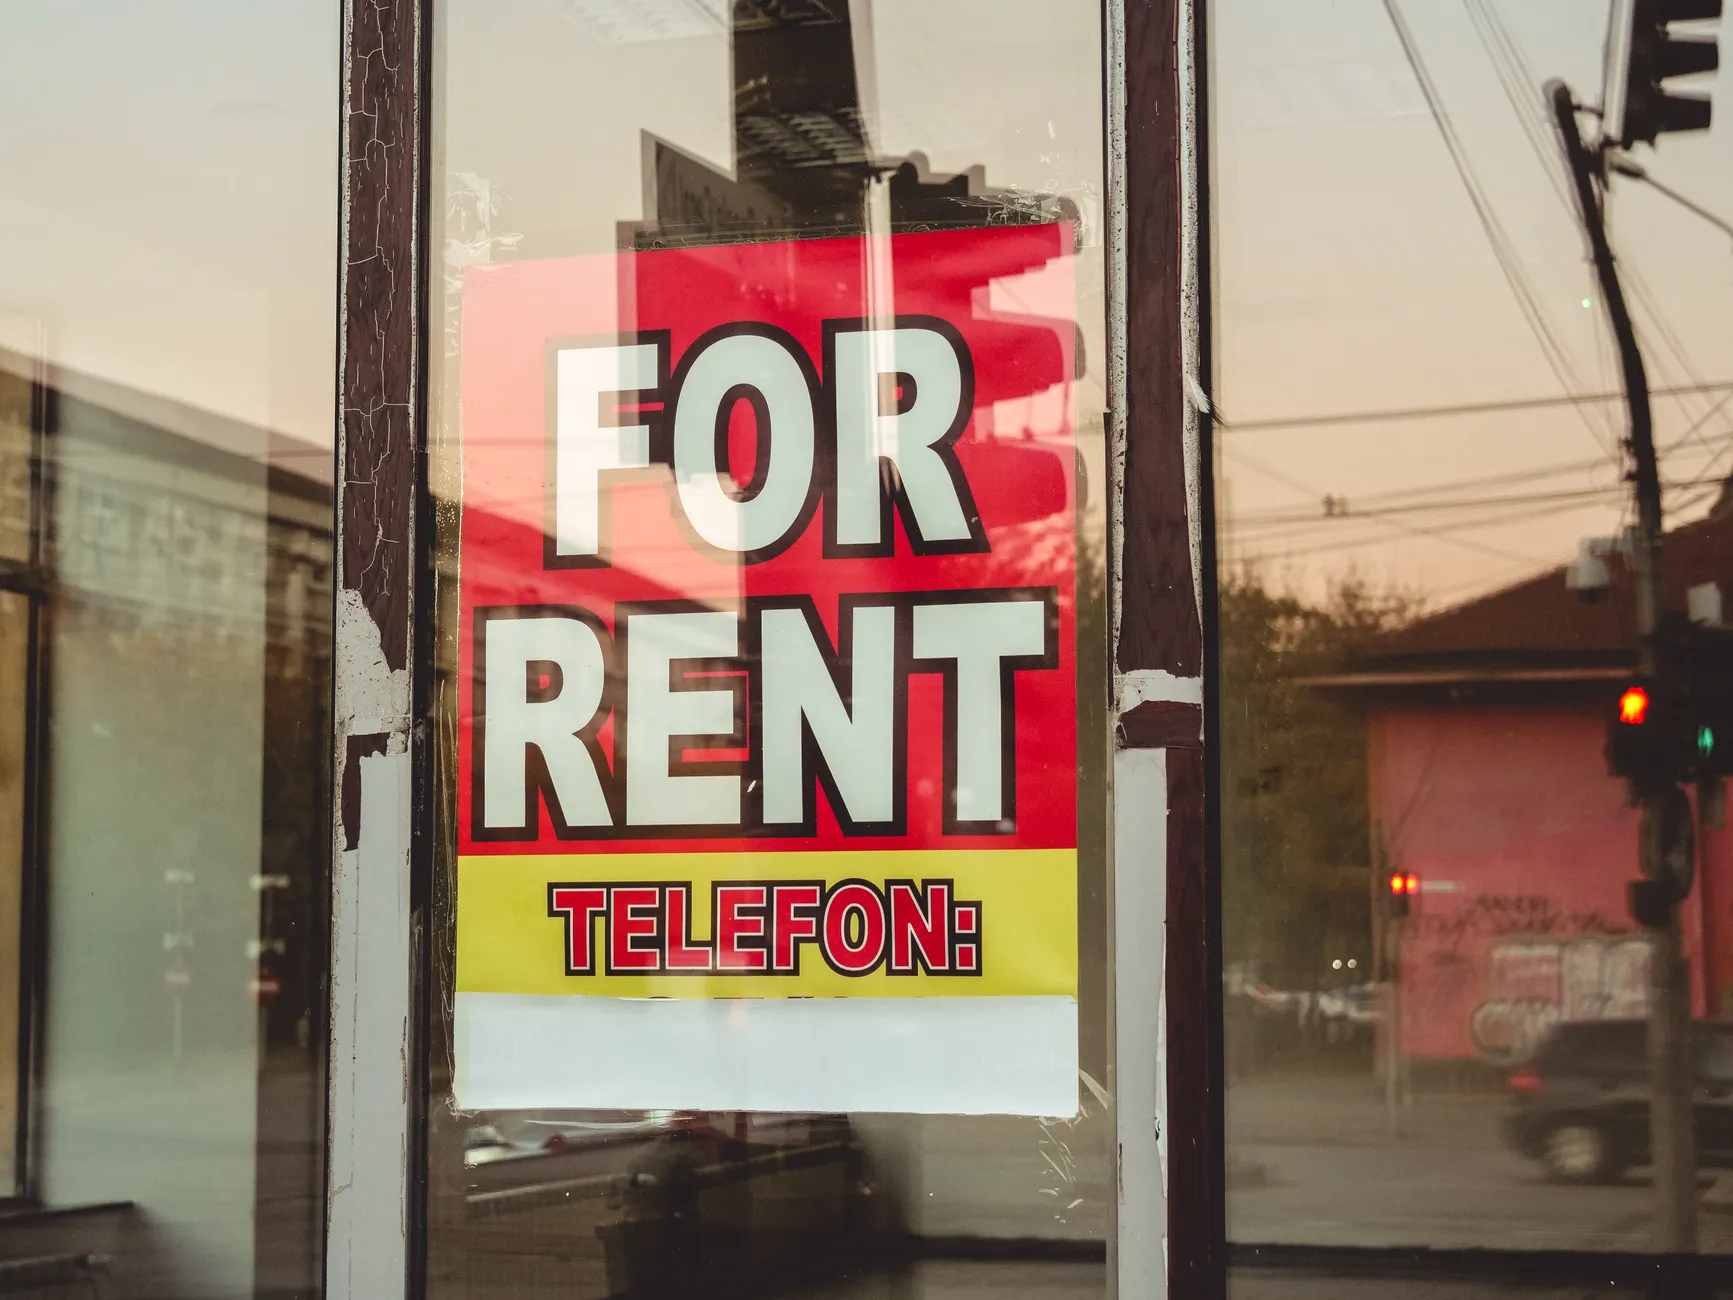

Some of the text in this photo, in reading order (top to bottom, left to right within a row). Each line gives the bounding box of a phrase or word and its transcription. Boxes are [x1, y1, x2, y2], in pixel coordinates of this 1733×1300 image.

[544, 314, 991, 570] FOR
[471, 586, 1058, 841] RENT
[547, 878, 983, 977] TELEFON:
